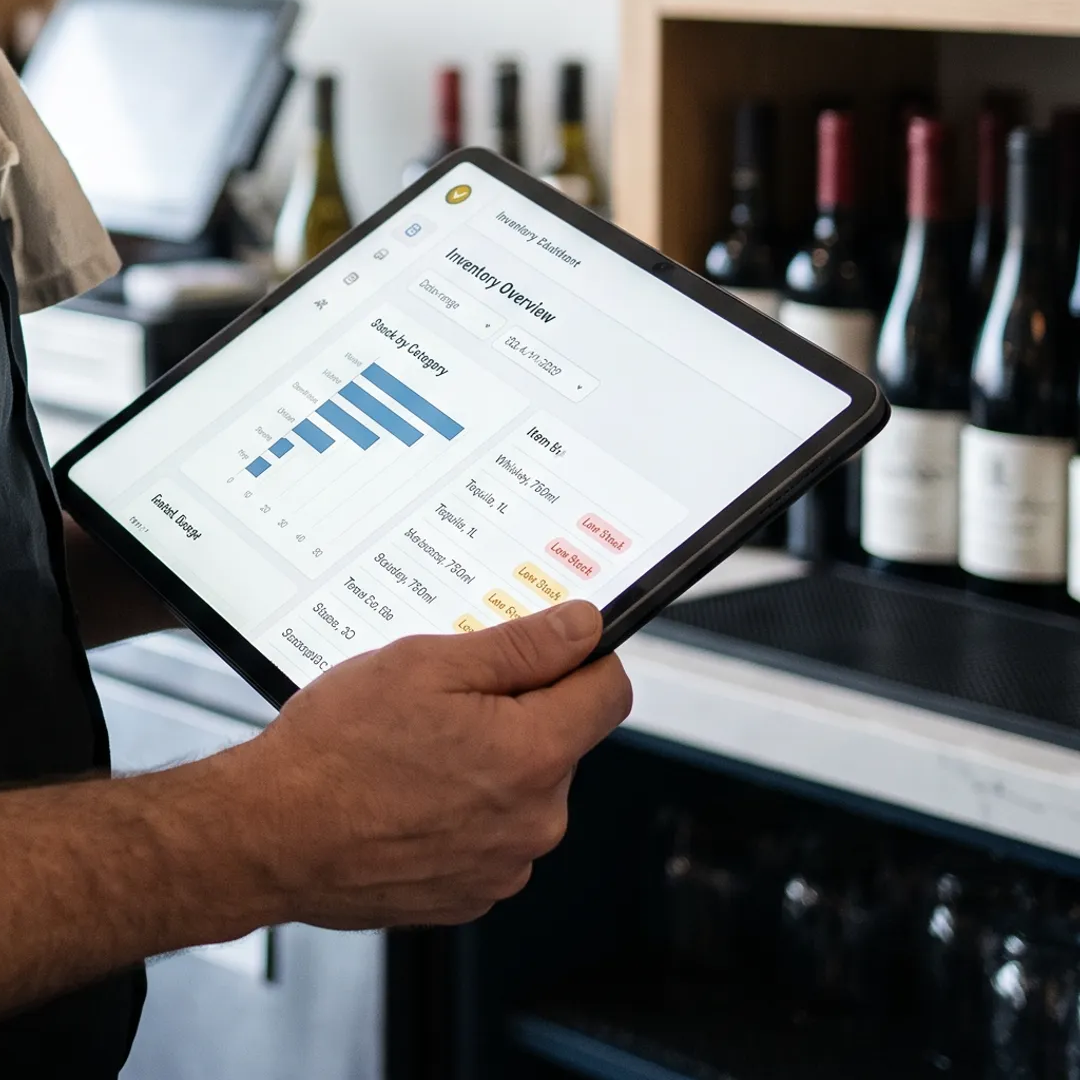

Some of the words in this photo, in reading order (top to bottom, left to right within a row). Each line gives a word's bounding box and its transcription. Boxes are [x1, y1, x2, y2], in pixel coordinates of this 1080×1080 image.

[445, 247, 501, 290] Inventory
[499, 282, 557, 324] Overview
[394, 334, 410, 350] by
[526, 426, 551, 448] Item
[496, 501, 509, 515] 1L
